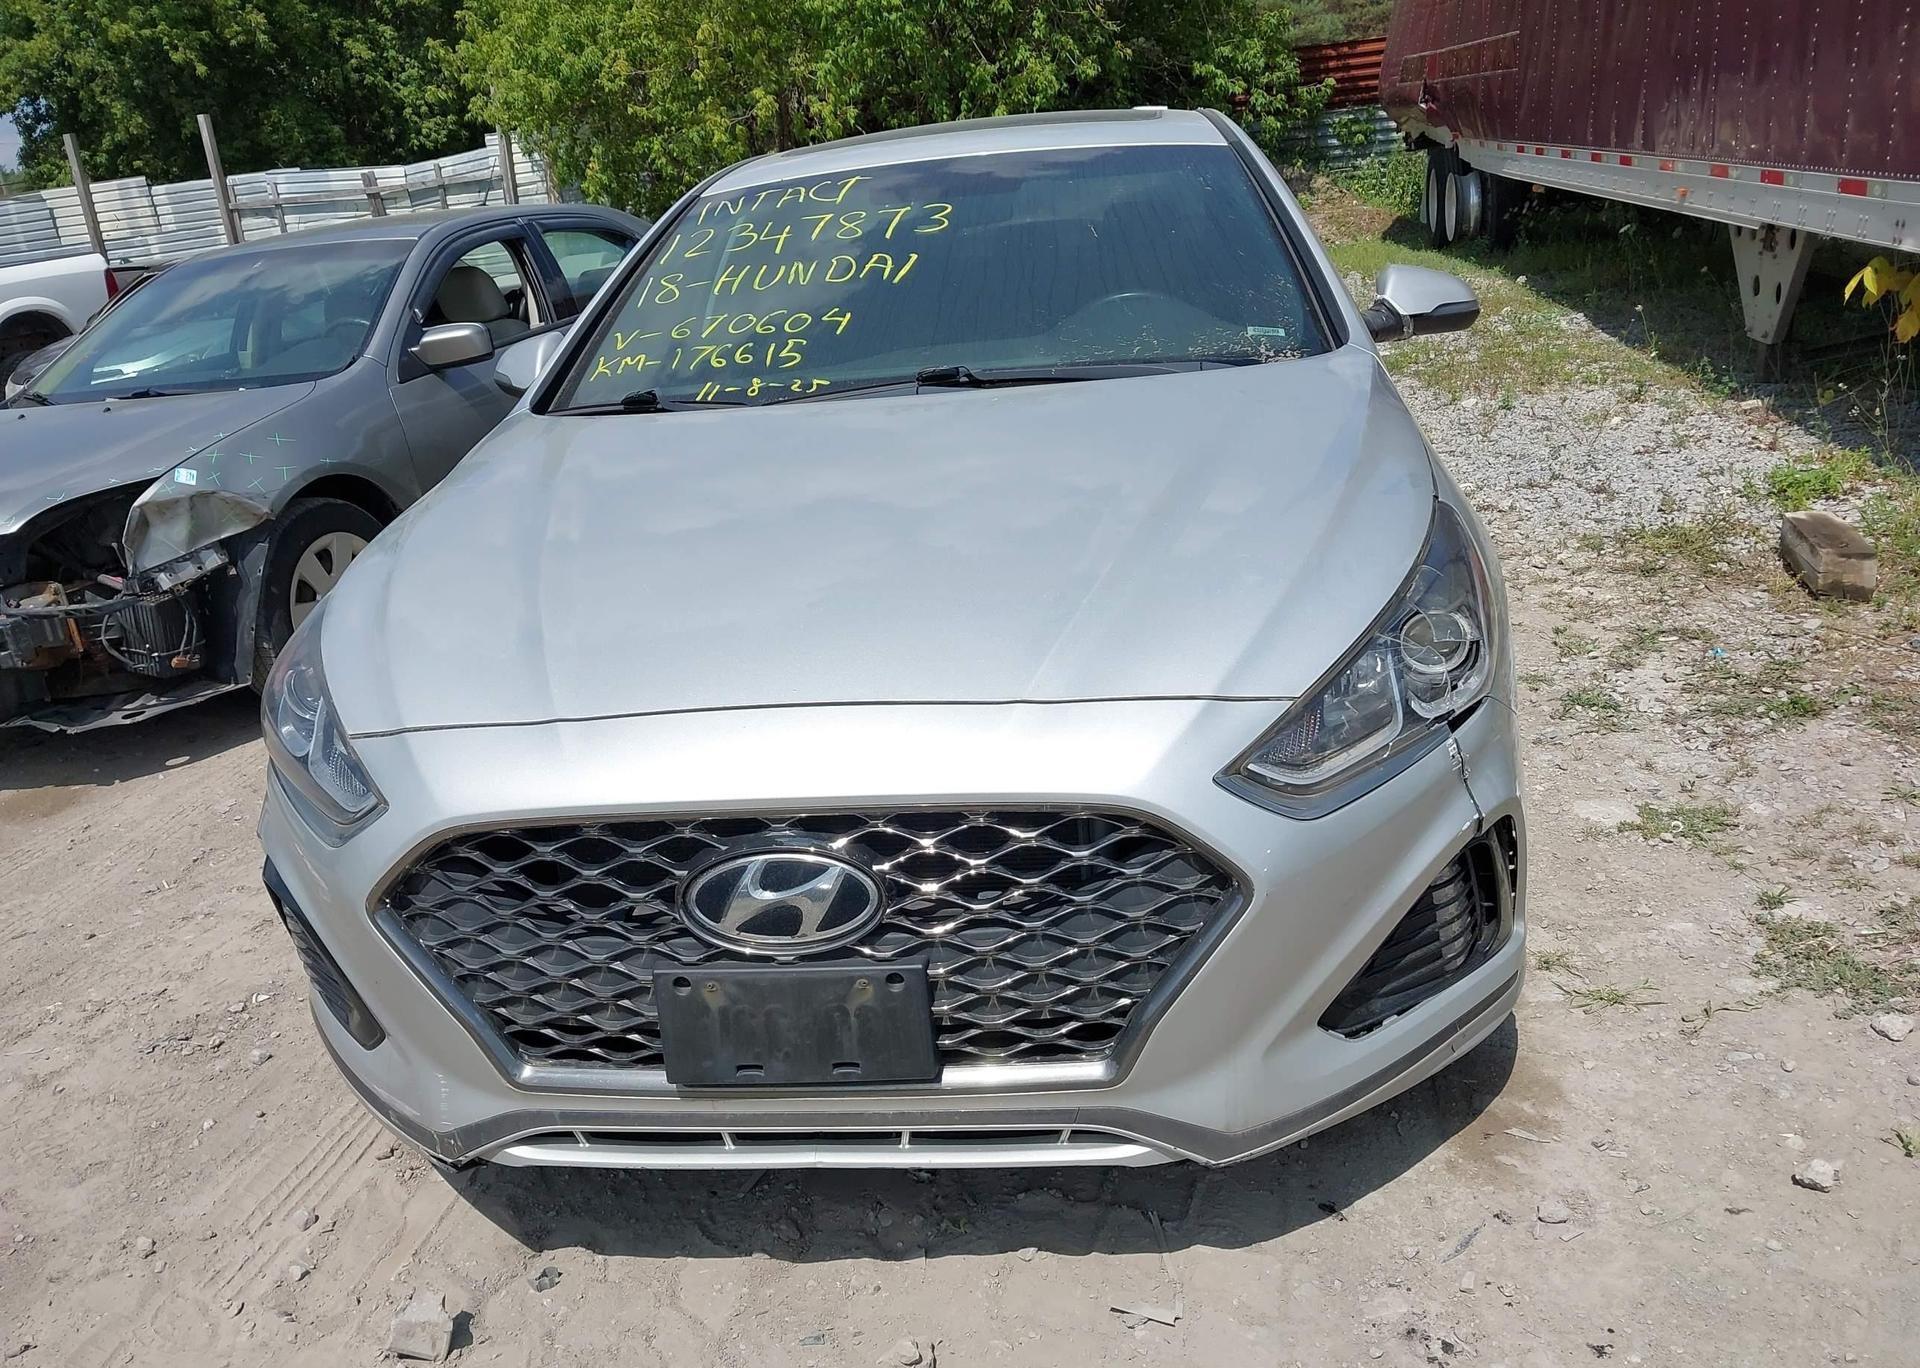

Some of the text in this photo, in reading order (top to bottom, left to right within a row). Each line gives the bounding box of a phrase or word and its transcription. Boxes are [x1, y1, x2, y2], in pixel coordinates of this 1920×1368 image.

[697, 176, 872, 225] INTACT
[659, 203, 953, 266] 12347873
[614, 308, 852, 351] V-670604
[589, 338, 807, 382] KM-176615
[695, 377, 832, 402] 11-8-25
